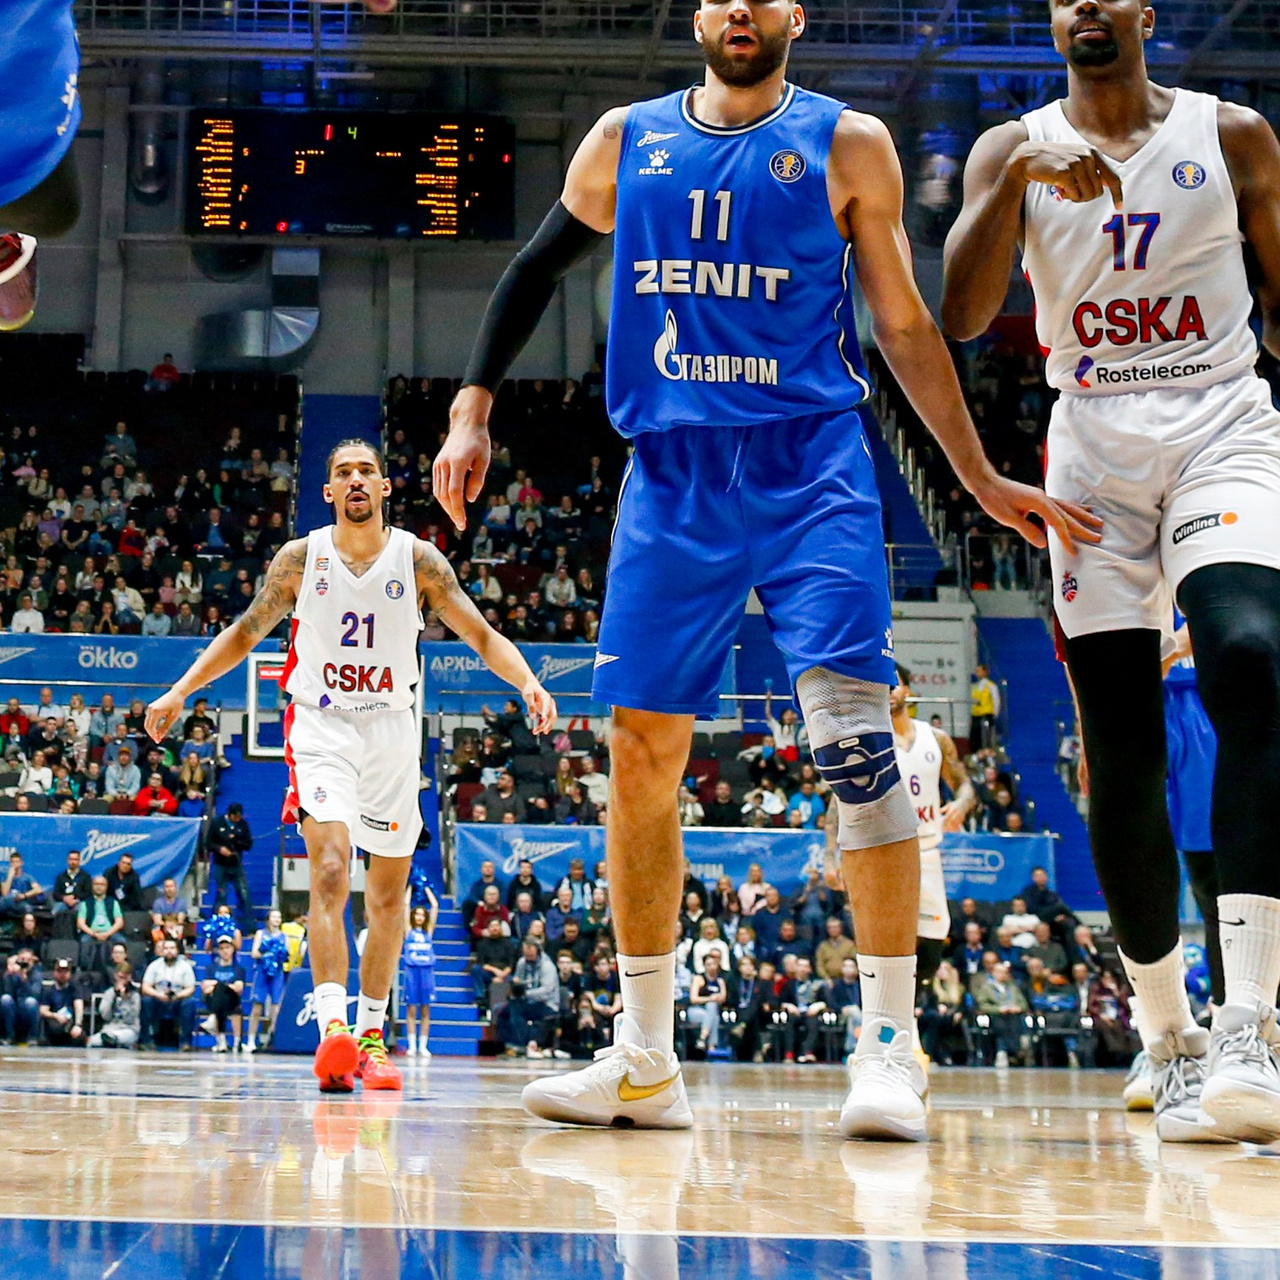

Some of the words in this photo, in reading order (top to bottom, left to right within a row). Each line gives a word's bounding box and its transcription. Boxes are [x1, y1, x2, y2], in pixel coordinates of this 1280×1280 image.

[687, 189, 732, 241] 11
[1102, 212, 1161, 271] 17
[633, 260, 789, 301] ZENIT
[1072, 295, 1209, 348] CSKA
[681, 354, 778, 385] ГАЗПРОМ
[1096, 362, 1212, 384] Rostelecom
[1174, 518, 1216, 542] Winline
[340, 612, 375, 649] 21
[323, 663, 393, 693] CSKA
